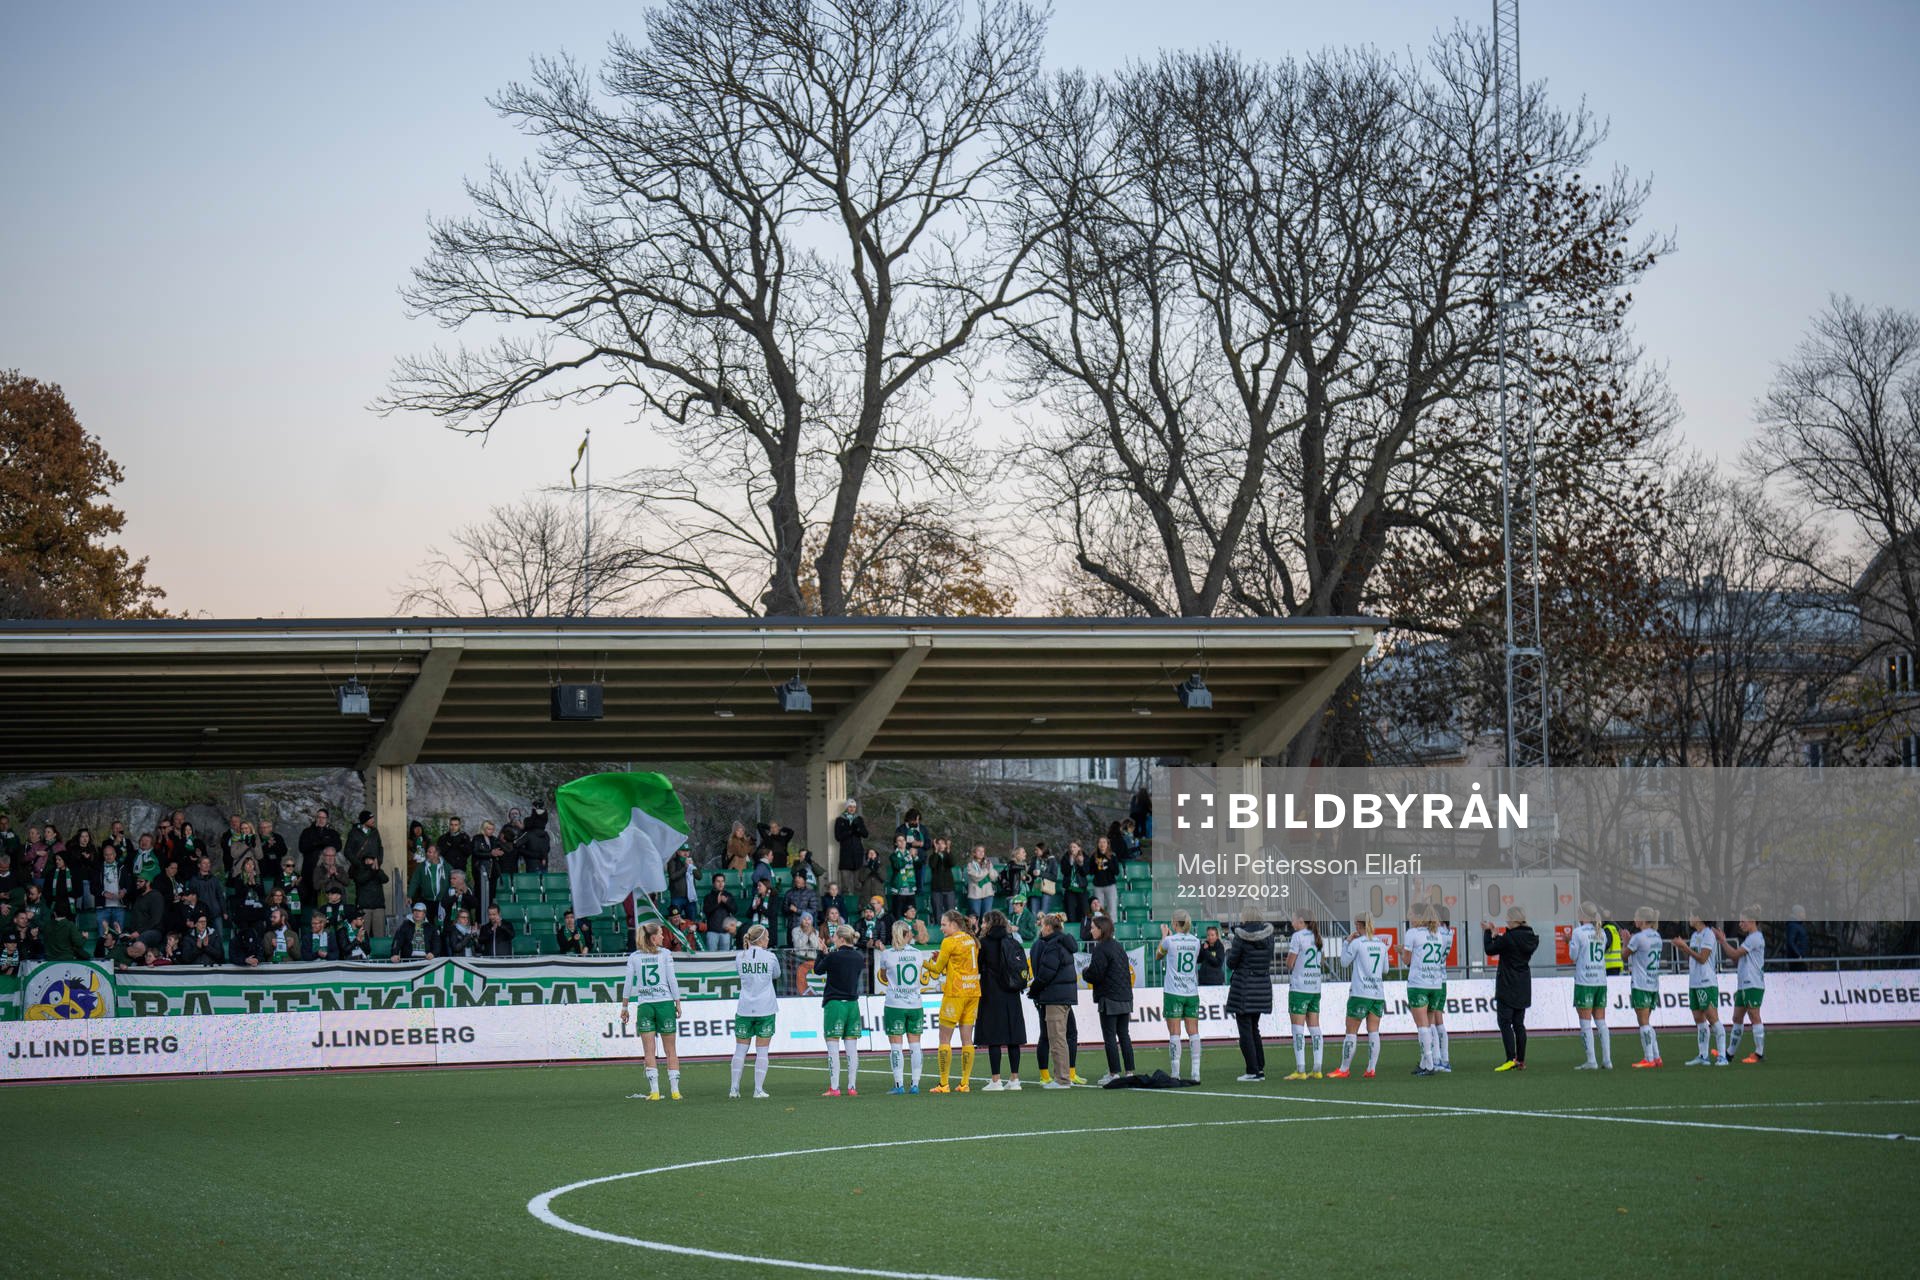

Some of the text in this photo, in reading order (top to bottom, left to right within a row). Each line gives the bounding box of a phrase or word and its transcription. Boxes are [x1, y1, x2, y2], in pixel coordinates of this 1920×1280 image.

[1589, 941, 1604, 962] 15
[741, 962, 768, 974] BAJEN
[1177, 952, 1194, 973] 18
[1369, 953, 1381, 974] 7
[641, 964, 661, 987] 13
[896, 963, 918, 986] 10
[8, 1035, 179, 1059] J.LINDEBERG
[312, 1026, 475, 1048] J.LINDEBERG
